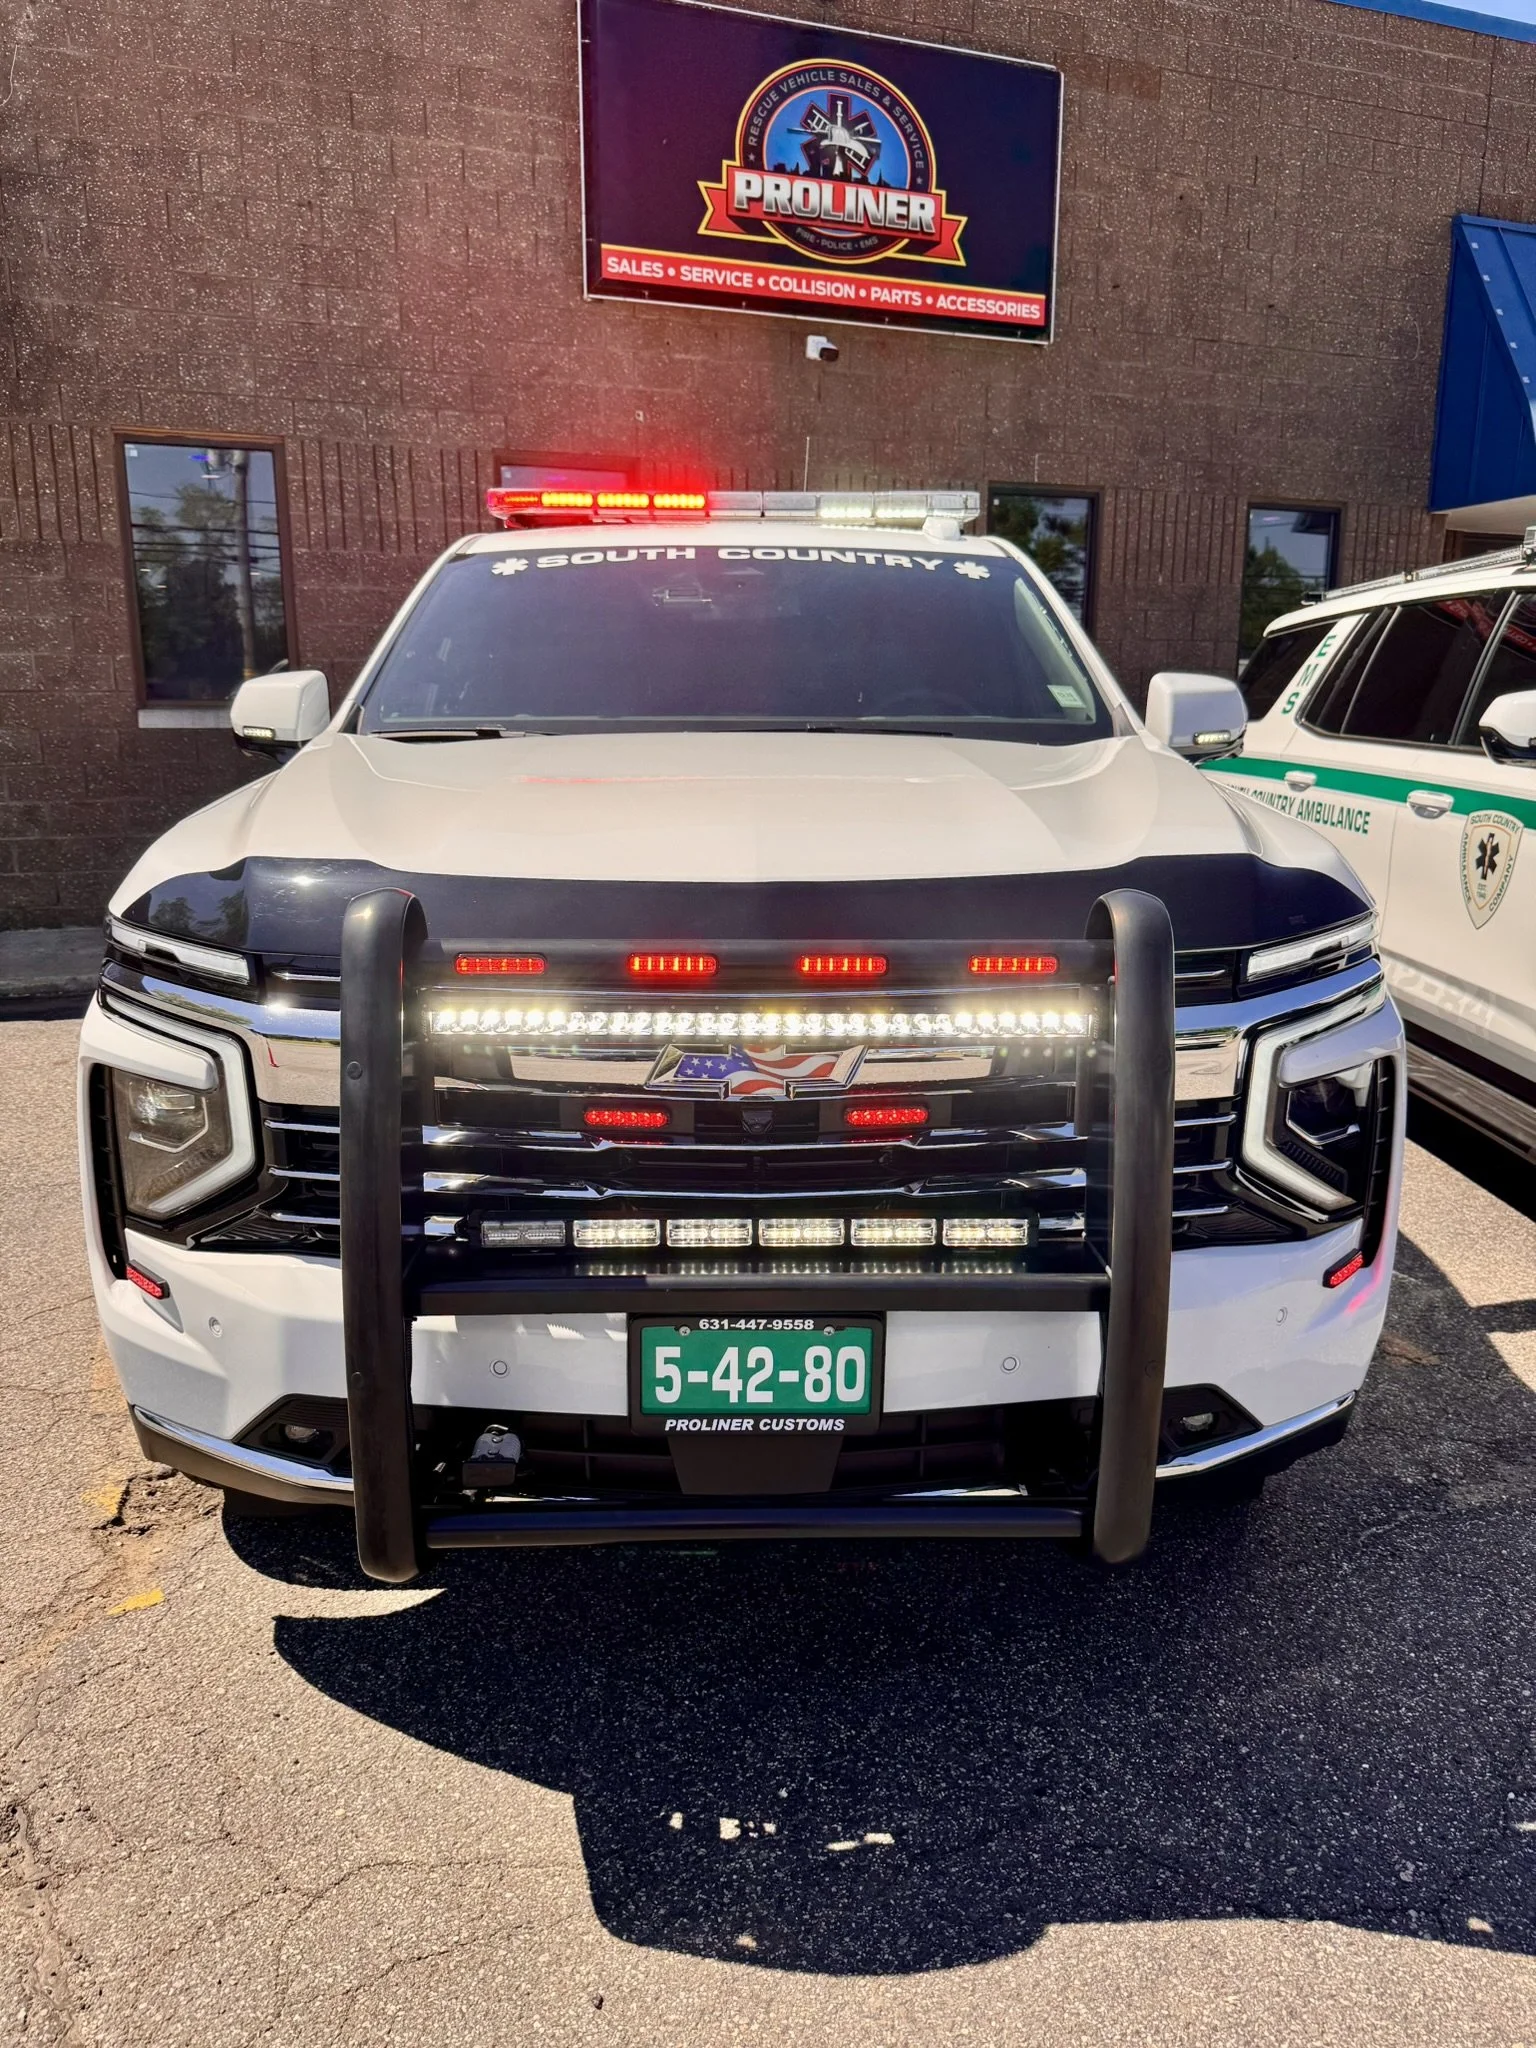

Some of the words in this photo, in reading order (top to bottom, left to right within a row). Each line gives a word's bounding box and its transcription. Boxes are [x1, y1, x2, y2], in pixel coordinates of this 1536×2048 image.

[748, 90, 780, 147] RESCUE
[779, 70, 835, 94] VEHICLE
[839, 72, 880, 97] SALES
[882, 95, 892, 107] &
[892, 106, 925, 169] SERVICE
[734, 170, 936, 234] PROLINER
[796, 226, 816, 243] FIRE
[820, 237, 853, 251] POLICE
[859, 235, 878, 249] EMS
[606, 256, 664, 279] SALES
[679, 265, 753, 288] SERVICE
[768, 275, 856, 299] COLLISION
[870, 286, 922, 307] PARTS
[936, 294, 1040, 319] ACCESSORIES
[536, 547, 696, 568] SOUTH
[717, 547, 944, 571] COUNTRY
[1296, 798, 1371, 834] AMBULANCE
[1470, 813, 1492, 825] SOUTH
[1492, 813, 1521, 833] COUNTRY
[1488, 855, 1513, 912] COMPANY
[699, 1319, 814, 1331] 631-447-9558
[655, 1345, 866, 1404] 5-42-80
[664, 1418, 754, 1432] PROLINER
[758, 1418, 845, 1432] CUSTOMS
